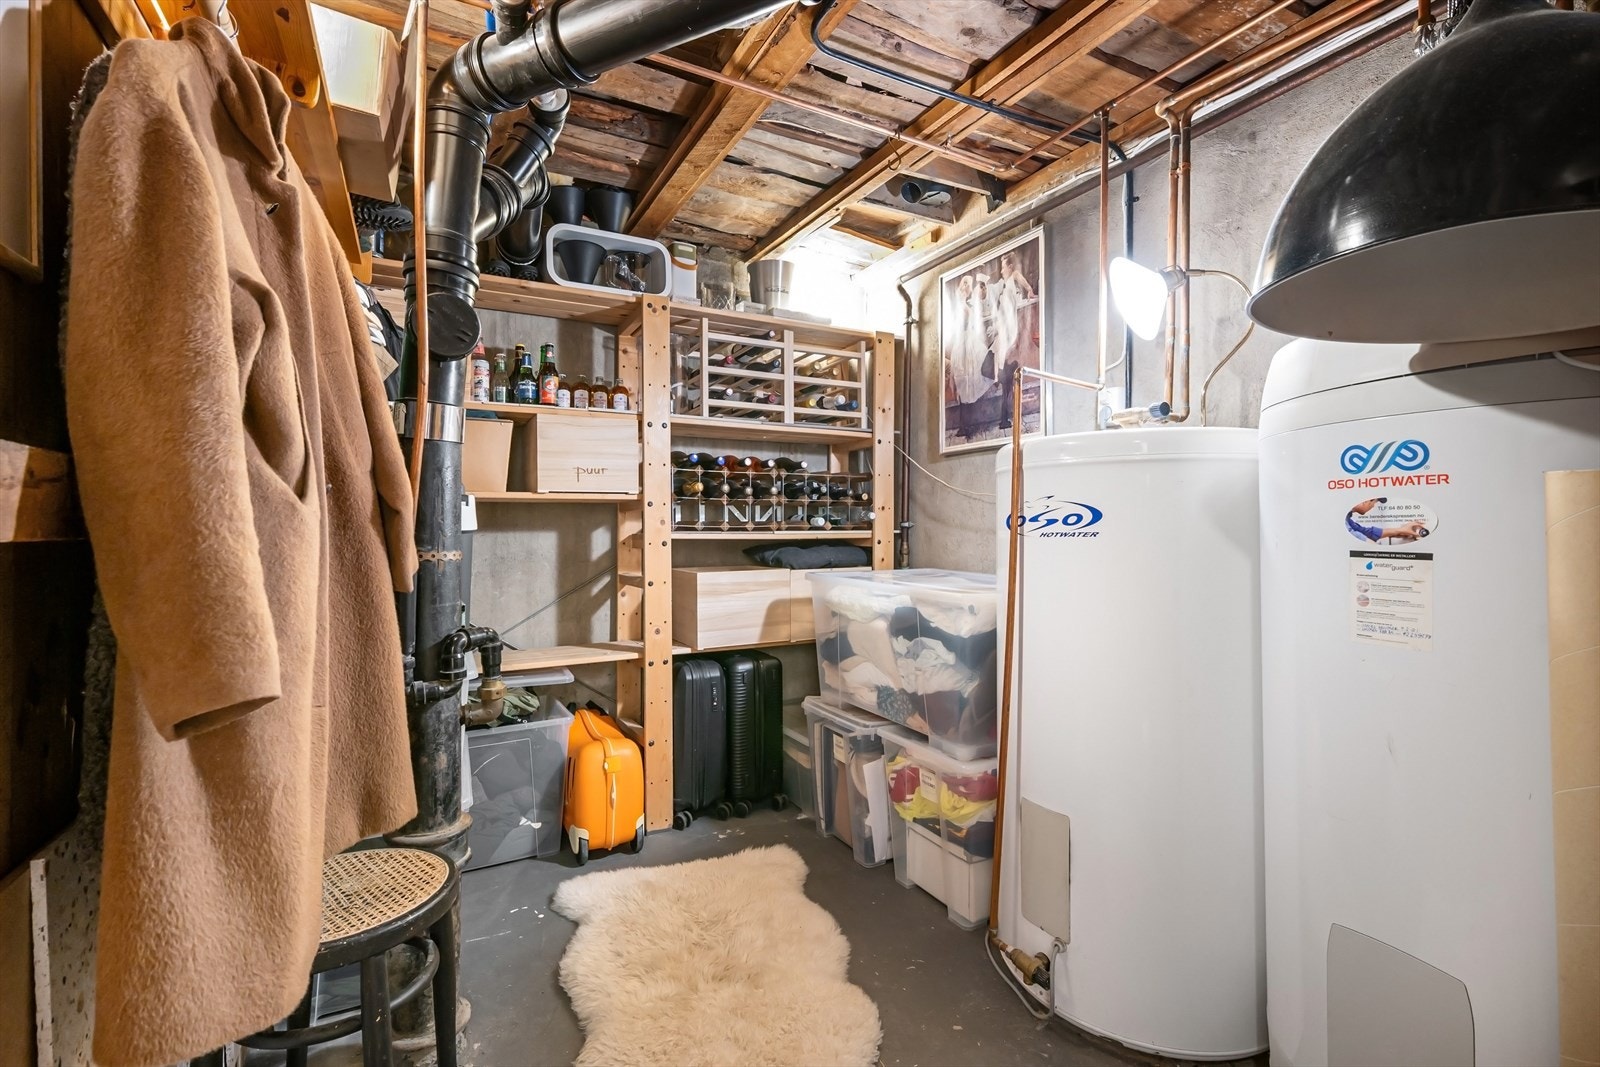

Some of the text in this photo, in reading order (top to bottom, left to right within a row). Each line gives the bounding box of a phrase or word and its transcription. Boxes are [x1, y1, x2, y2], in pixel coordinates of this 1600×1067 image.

[572, 466, 608, 483] puur
[1328, 473, 1450, 490] OSO HOTWATER
